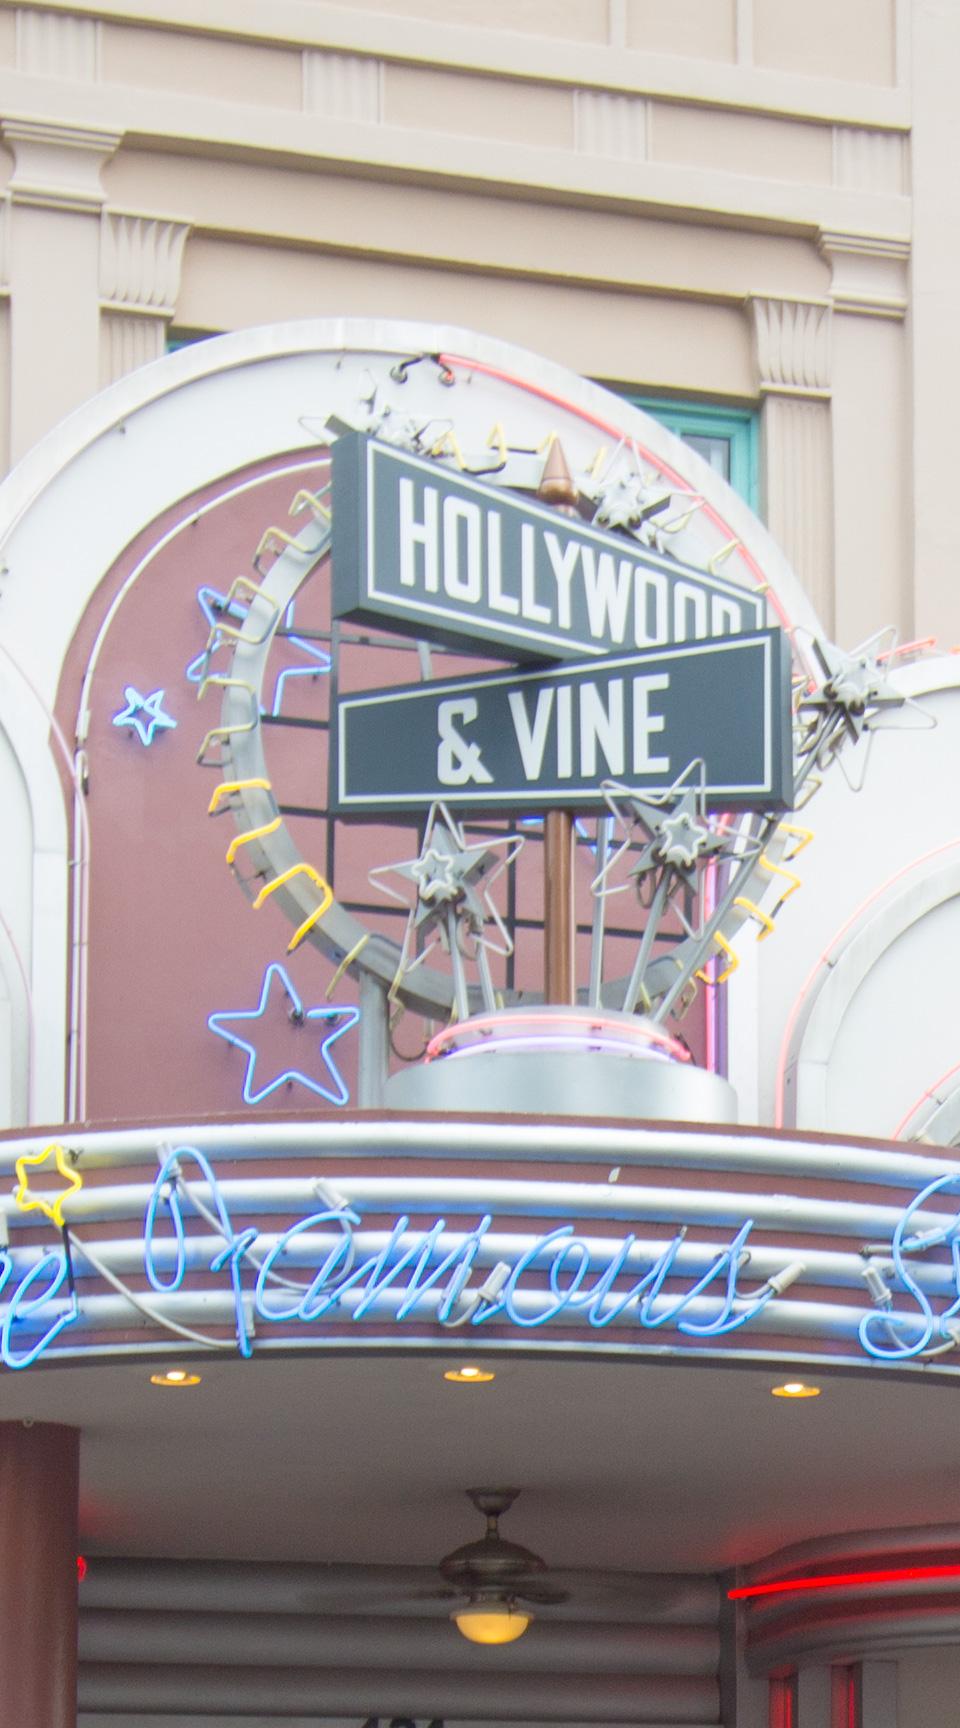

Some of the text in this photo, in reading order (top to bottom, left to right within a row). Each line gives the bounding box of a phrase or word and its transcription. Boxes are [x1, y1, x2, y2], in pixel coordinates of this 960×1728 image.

[436, 672, 671, 786] & VINE
[144, 1145, 776, 1358] Famous
